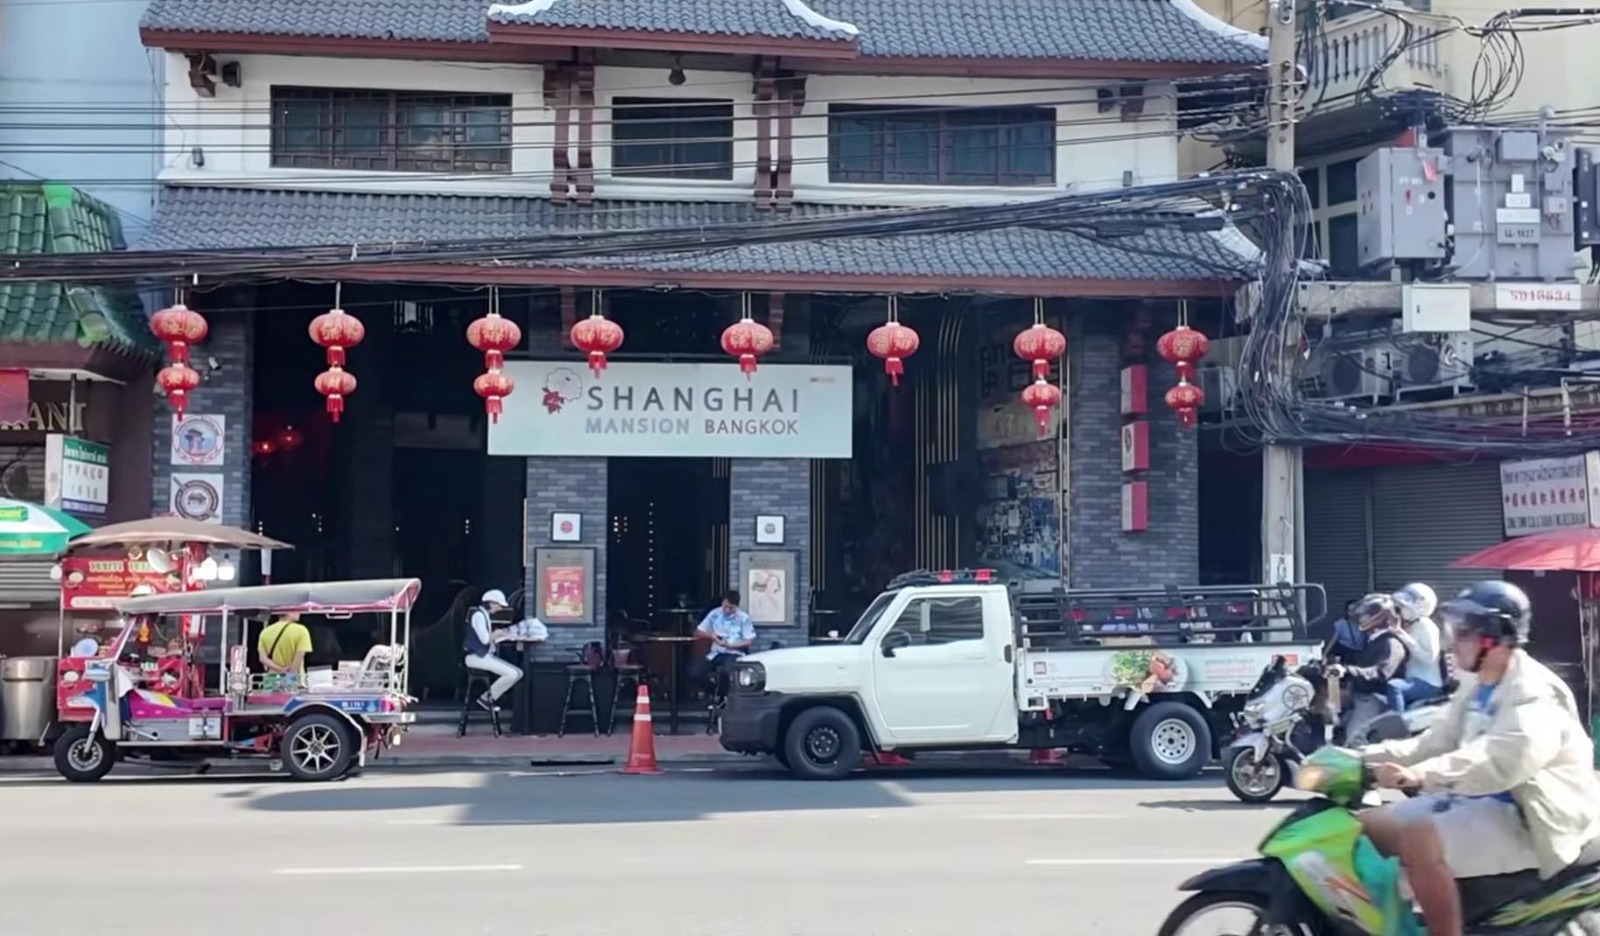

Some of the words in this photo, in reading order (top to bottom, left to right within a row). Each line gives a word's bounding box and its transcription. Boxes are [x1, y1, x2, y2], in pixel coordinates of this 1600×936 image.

[587, 386, 798, 413] SHANGHAI
[585, 417, 690, 434] MANSION
[704, 419, 799, 435] BANGKOK
